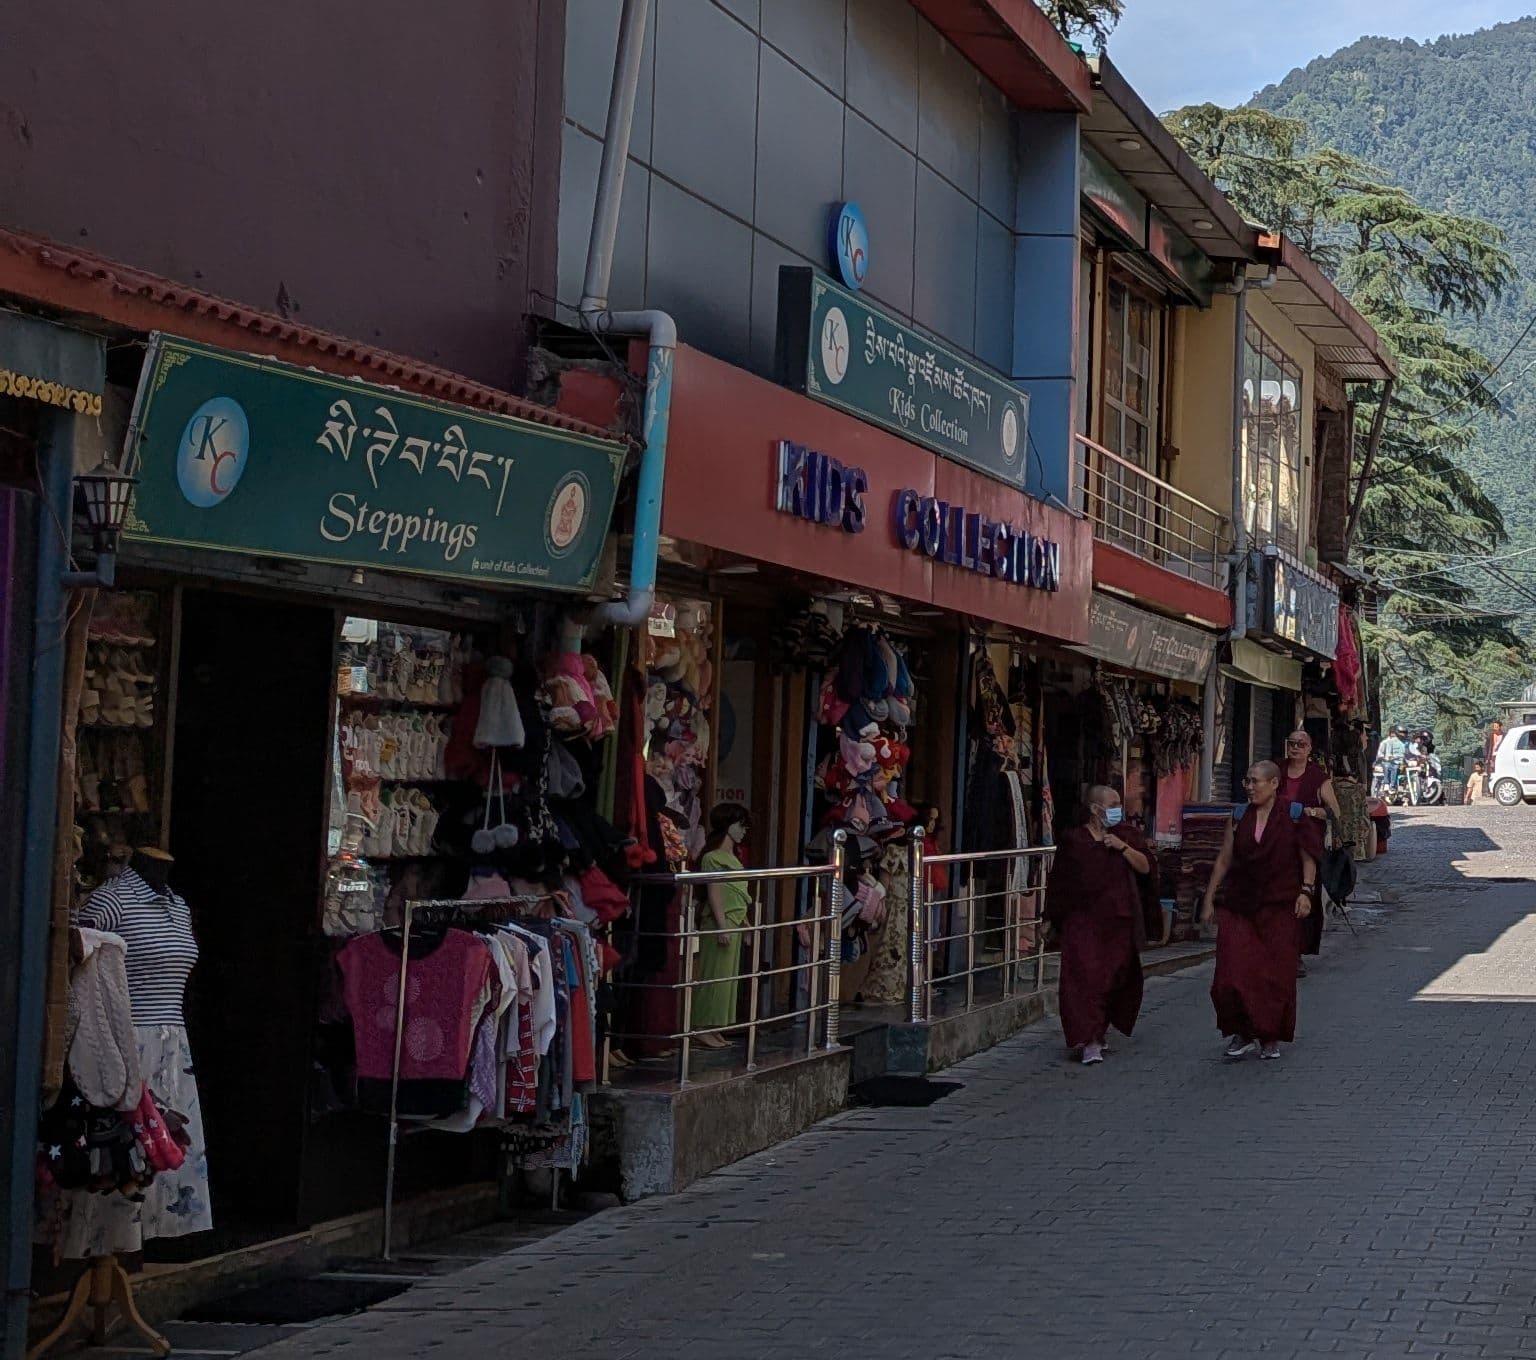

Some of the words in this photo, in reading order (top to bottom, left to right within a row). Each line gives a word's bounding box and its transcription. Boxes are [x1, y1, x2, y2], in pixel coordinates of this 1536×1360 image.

[889, 387, 916, 428] Kids
[921, 403, 969, 446] Collection
[189, 415, 238, 496] KC
[320, 492, 479, 561] Steppings
[777, 440, 868, 534] KIDS
[896, 488, 1060, 593] COLLECTION
